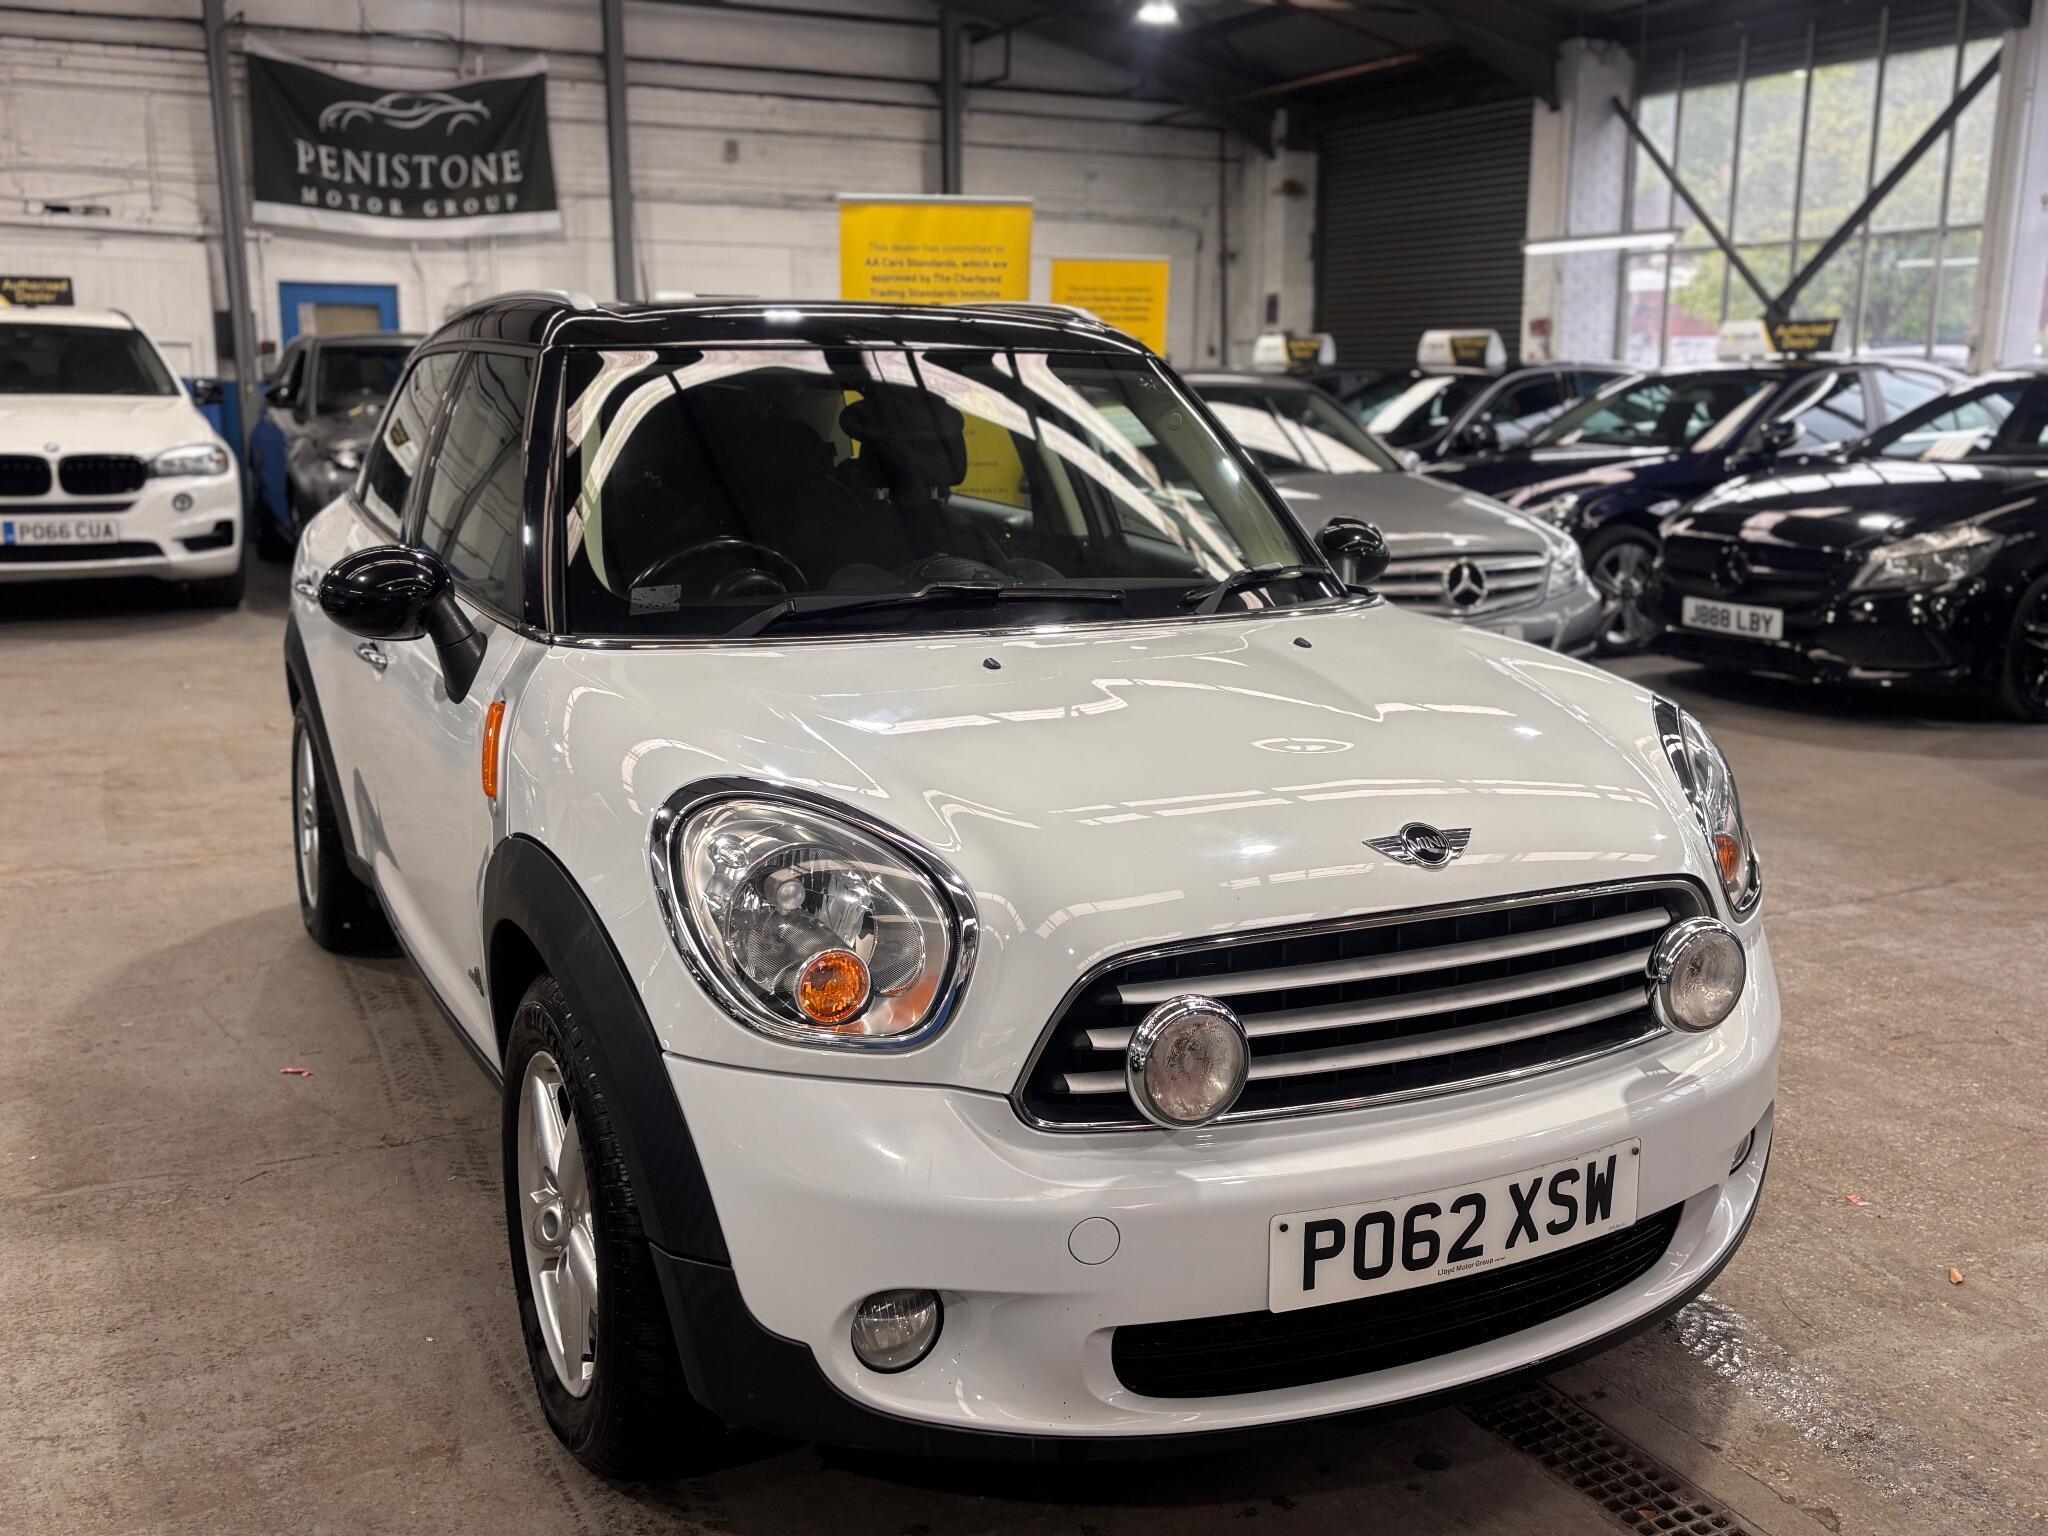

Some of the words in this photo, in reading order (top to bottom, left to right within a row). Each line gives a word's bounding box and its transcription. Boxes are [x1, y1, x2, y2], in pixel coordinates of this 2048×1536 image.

[295, 138, 524, 190] PENISTONE
[301, 185, 404, 217] MOTOR
[423, 194, 519, 218] GROUP
[865, 258, 879, 267] AA
[882, 257, 905, 267] Cars
[19, 521, 71, 540] PO66
[76, 521, 113, 539] CUA
[1737, 610, 1774, 634] LBY
[1302, 1192, 1487, 1292] PO62
[1505, 1154, 1617, 1251] XSW
[1437, 1267, 1455, 1276] Lloyd
[1455, 1263, 1474, 1273] Motor
[1475, 1258, 1494, 1268] Group
